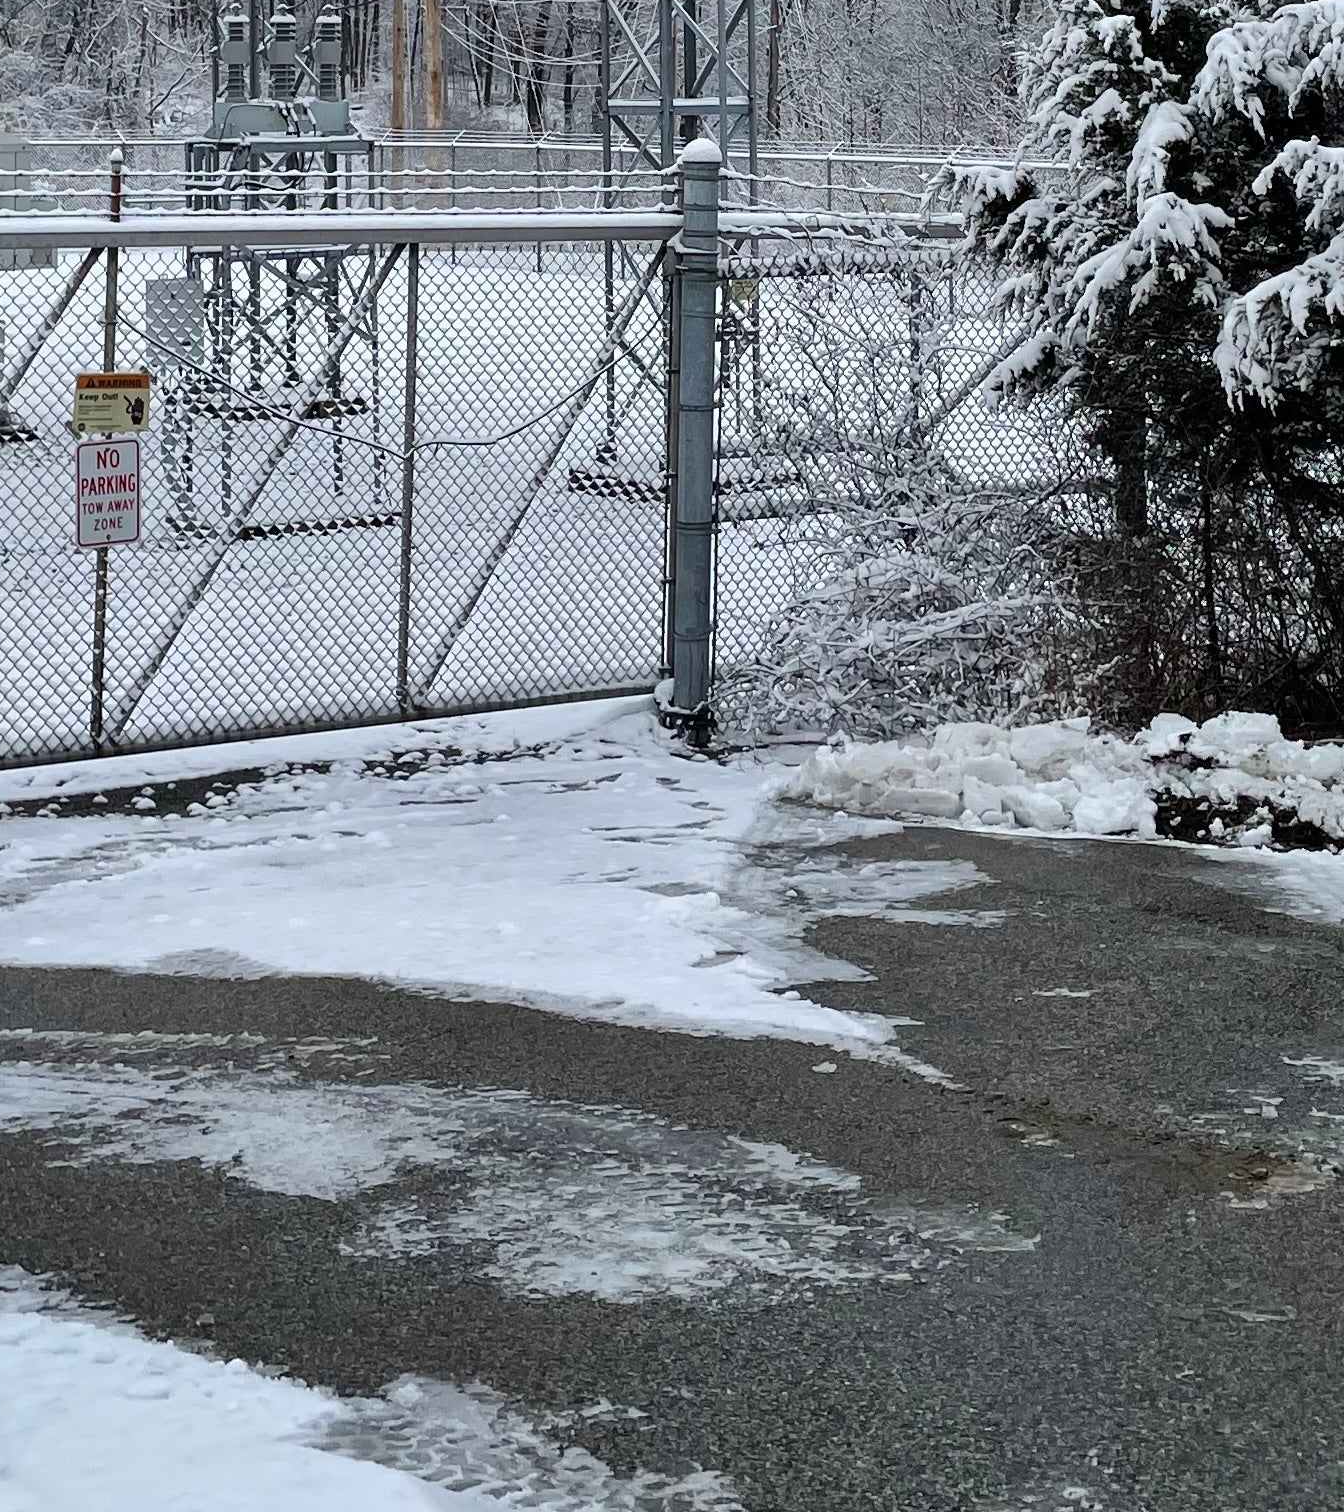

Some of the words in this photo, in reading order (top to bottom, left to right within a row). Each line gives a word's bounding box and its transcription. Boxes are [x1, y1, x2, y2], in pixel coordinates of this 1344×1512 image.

[98, 379, 142, 388] WARNING
[79, 393, 99, 402] Keep
[97, 449, 120, 469] NO
[81, 473, 136, 497] PARKING
[82, 502, 104, 515] TOW
[107, 498, 135, 513] AWAY
[94, 516, 123, 531] ZONE
